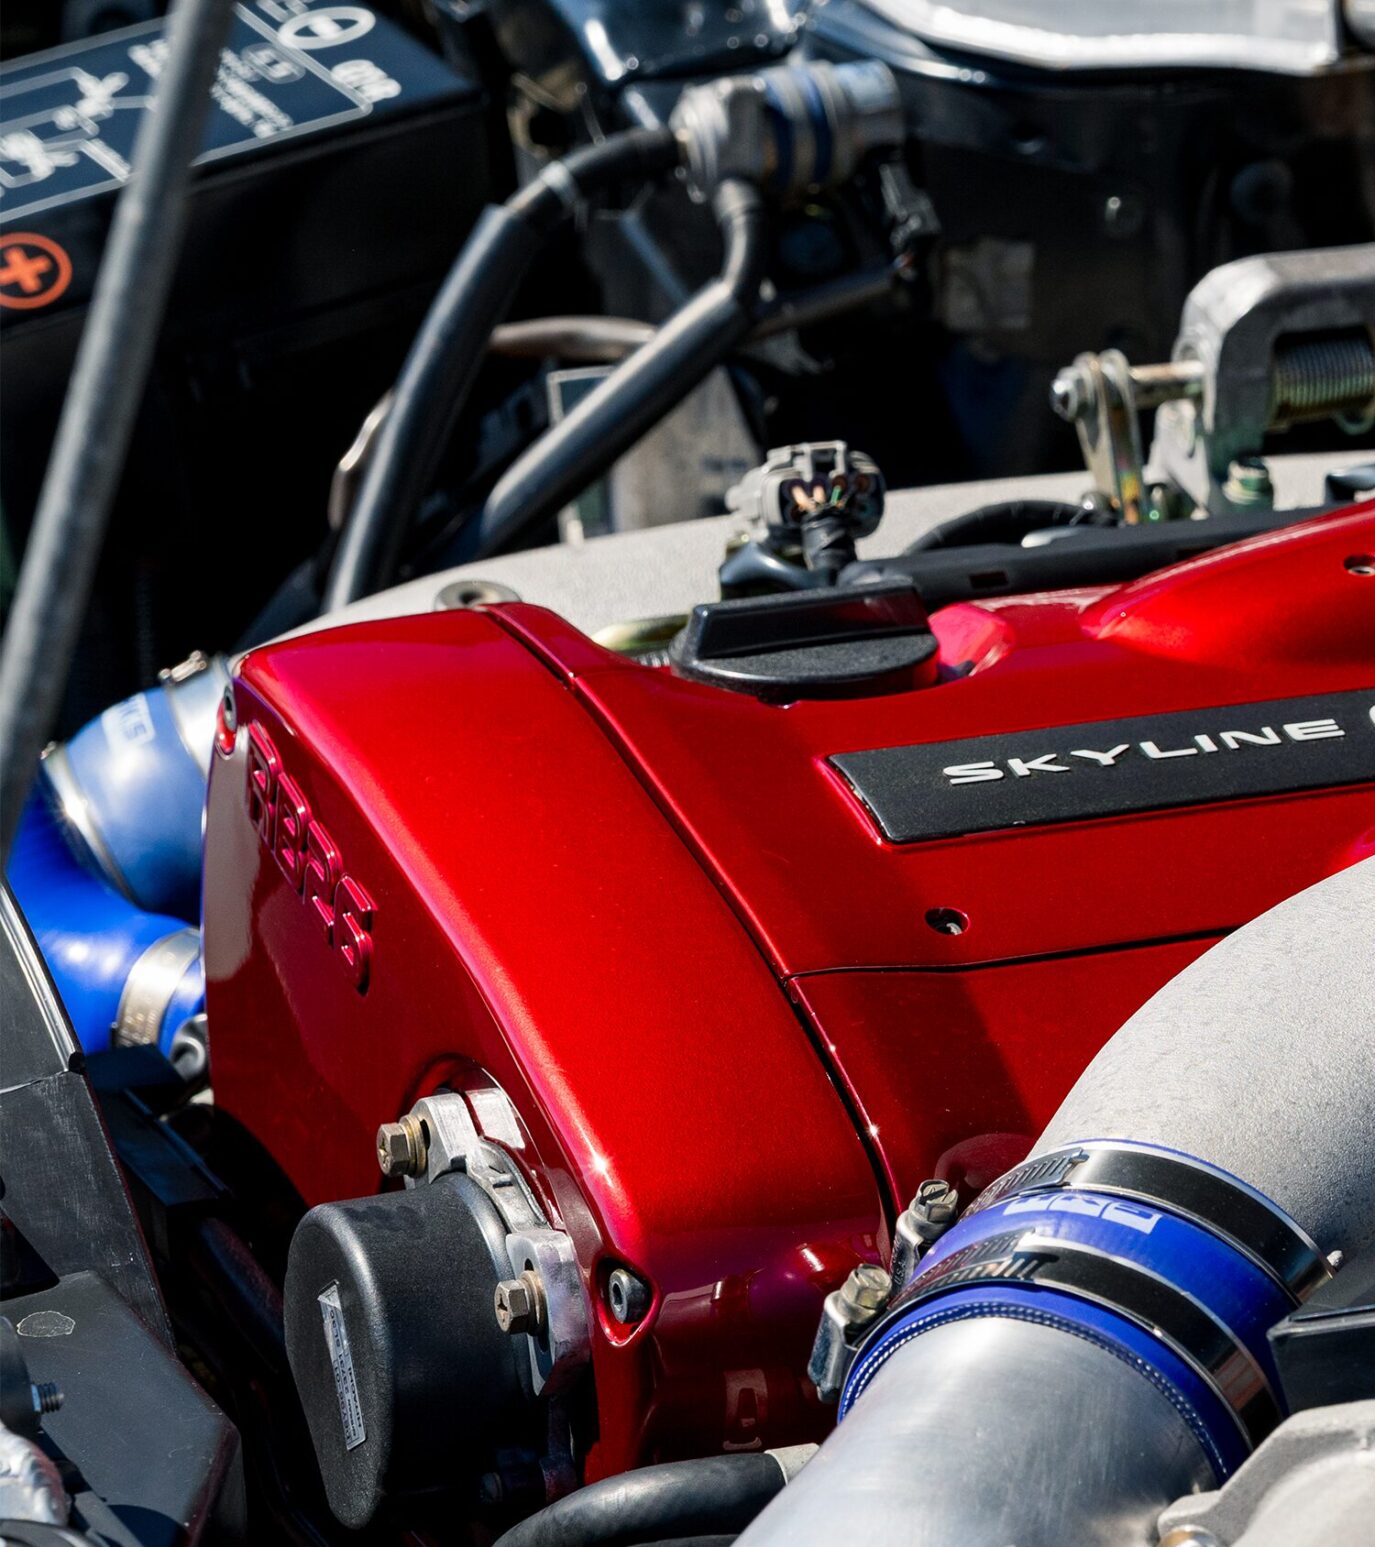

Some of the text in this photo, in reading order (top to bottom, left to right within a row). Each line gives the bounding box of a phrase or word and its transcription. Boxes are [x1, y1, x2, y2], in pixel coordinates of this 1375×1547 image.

[942, 718, 1346, 786] SKYLINE
[246, 719, 378, 998] RB26
[348, 1367, 362, 1428] HITACHI
